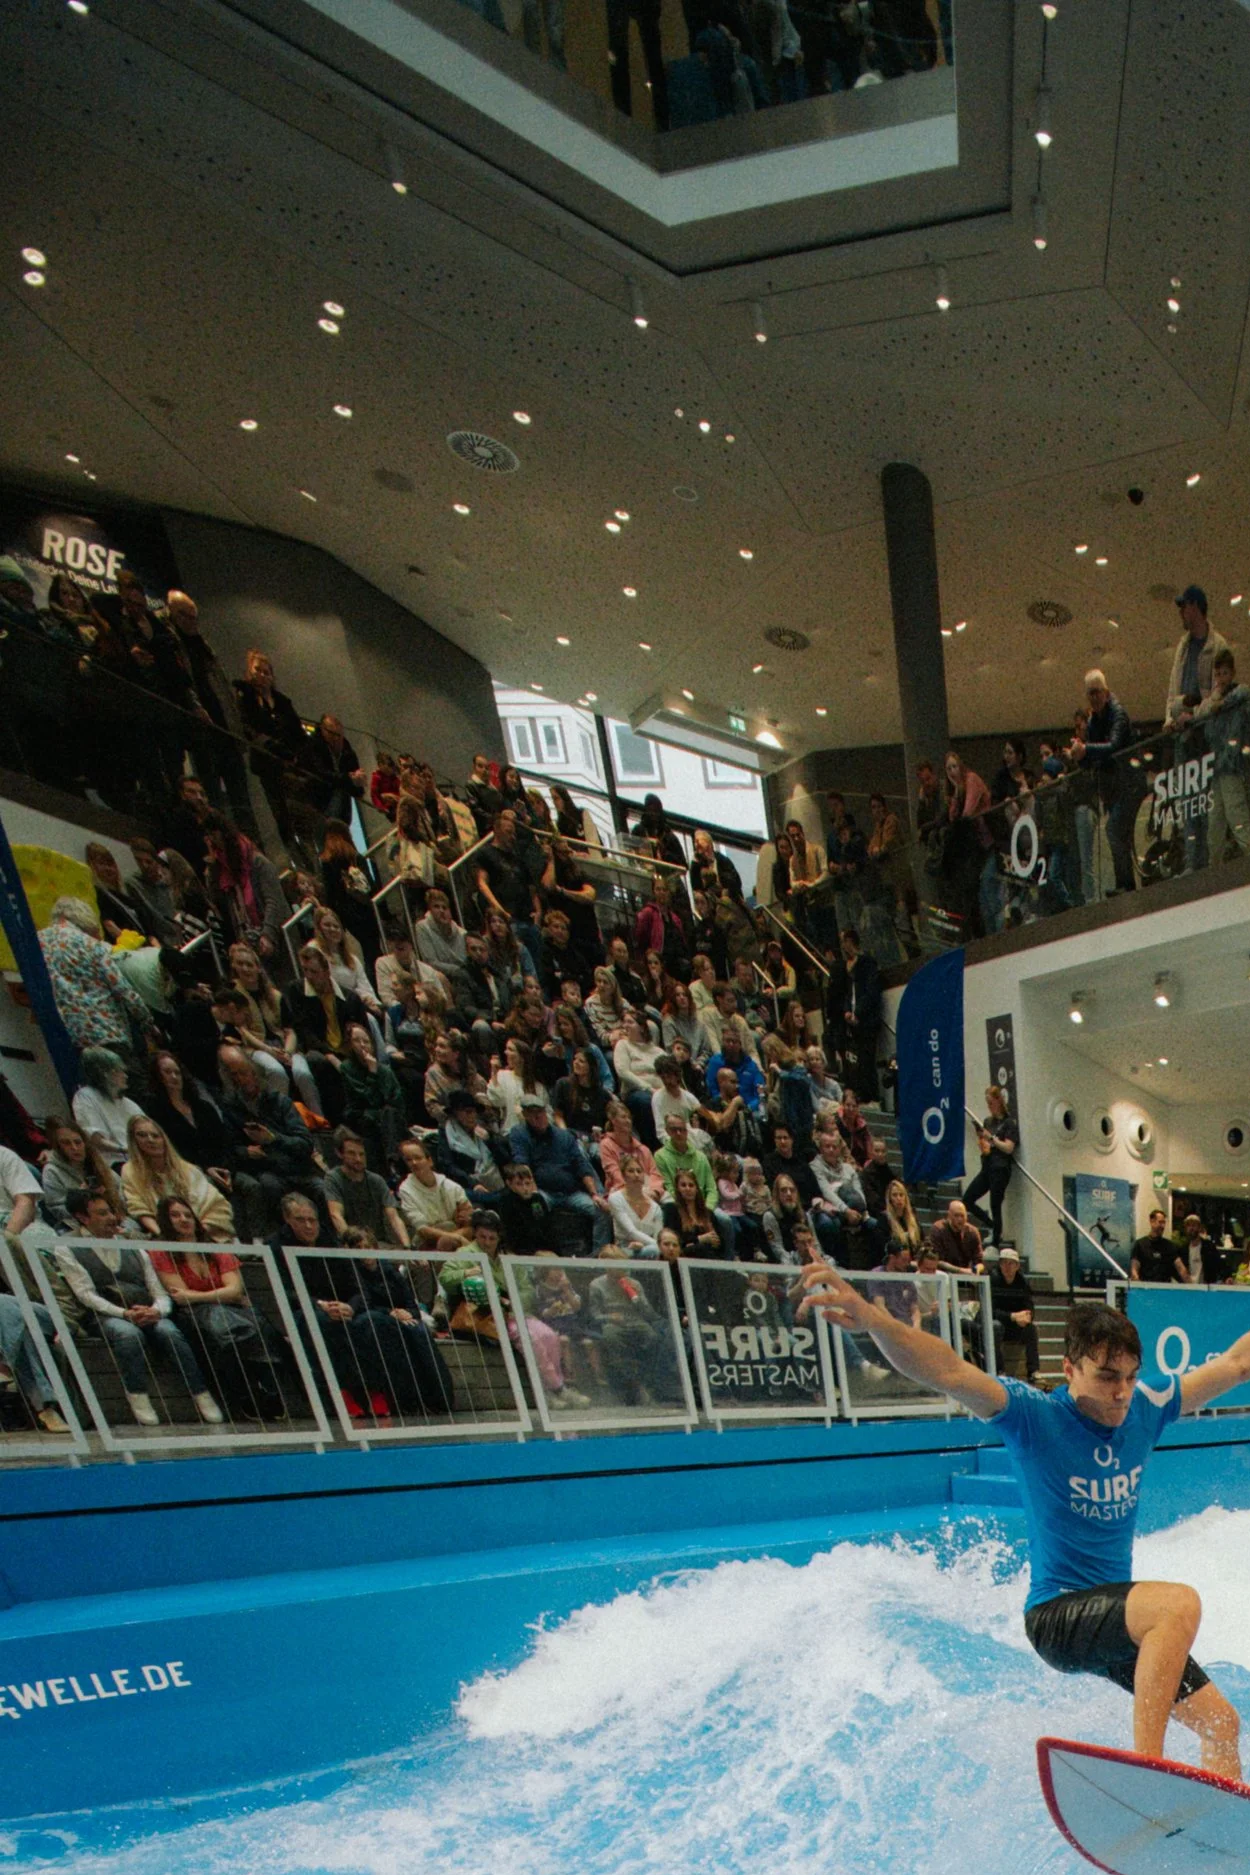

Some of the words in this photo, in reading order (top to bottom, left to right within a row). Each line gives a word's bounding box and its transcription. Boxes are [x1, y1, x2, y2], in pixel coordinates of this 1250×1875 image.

[42, 527, 126, 582] ROSE
[1154, 752, 1216, 803] SURF
[1153, 790, 1215, 831] MASTERS
[1010, 814, 1048, 886] O2
[927, 1027, 939, 1053] do
[932, 1056, 942, 1089] can
[922, 1096, 950, 1145] O2
[1069, 1465, 1142, 1502] SURF
